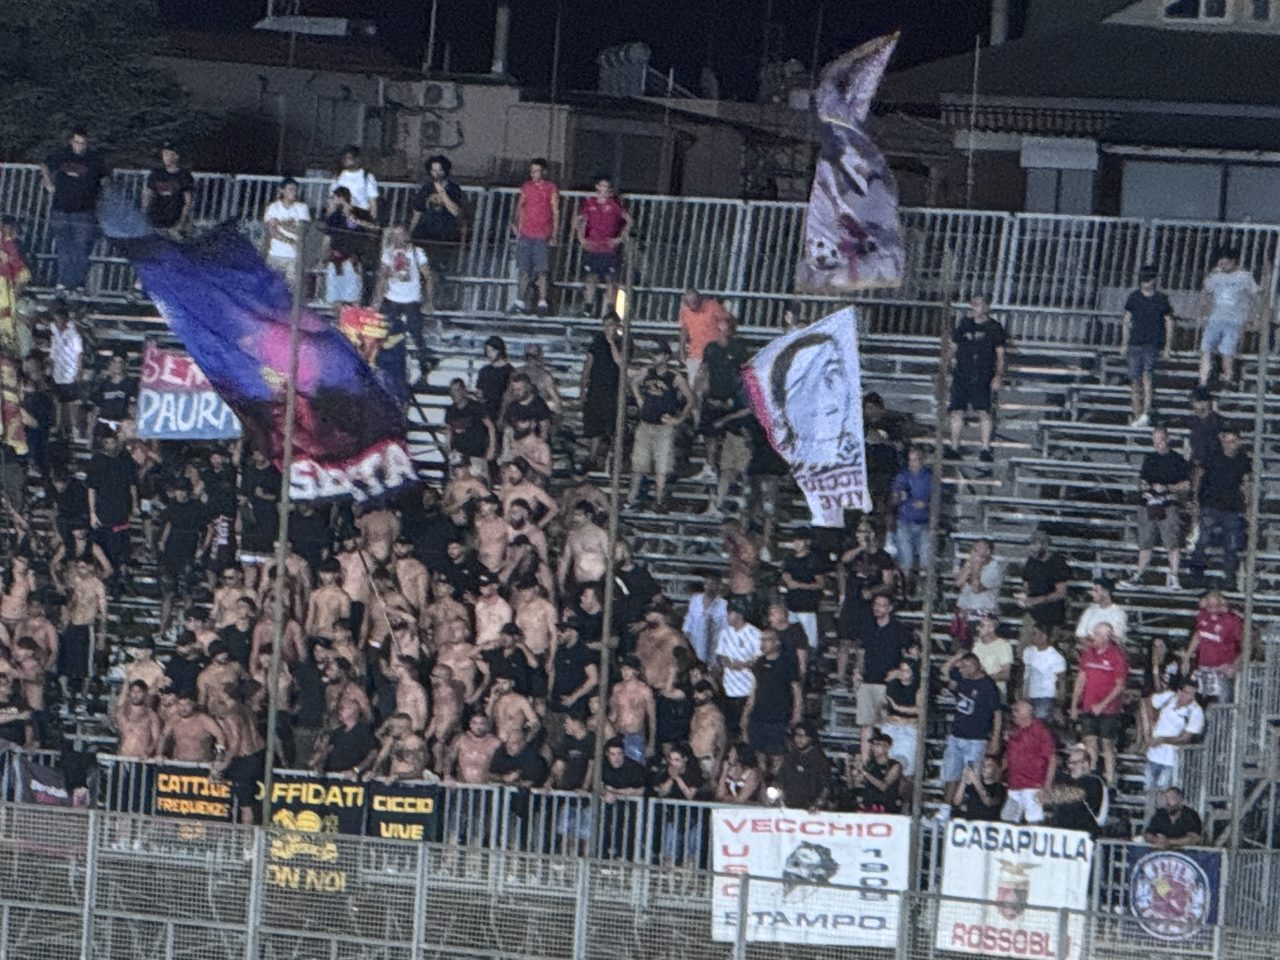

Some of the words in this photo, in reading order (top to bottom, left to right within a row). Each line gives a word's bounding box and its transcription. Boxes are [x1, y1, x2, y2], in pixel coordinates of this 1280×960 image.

[372, 795, 434, 814] CICCIO
[380, 821, 424, 840] VIVE
[723, 817, 892, 838] VECCHIO
[951, 823, 1089, 861] CASAPULLA
[724, 910, 888, 931] STAMPO
[951, 922, 1072, 960] ROSSOBL
